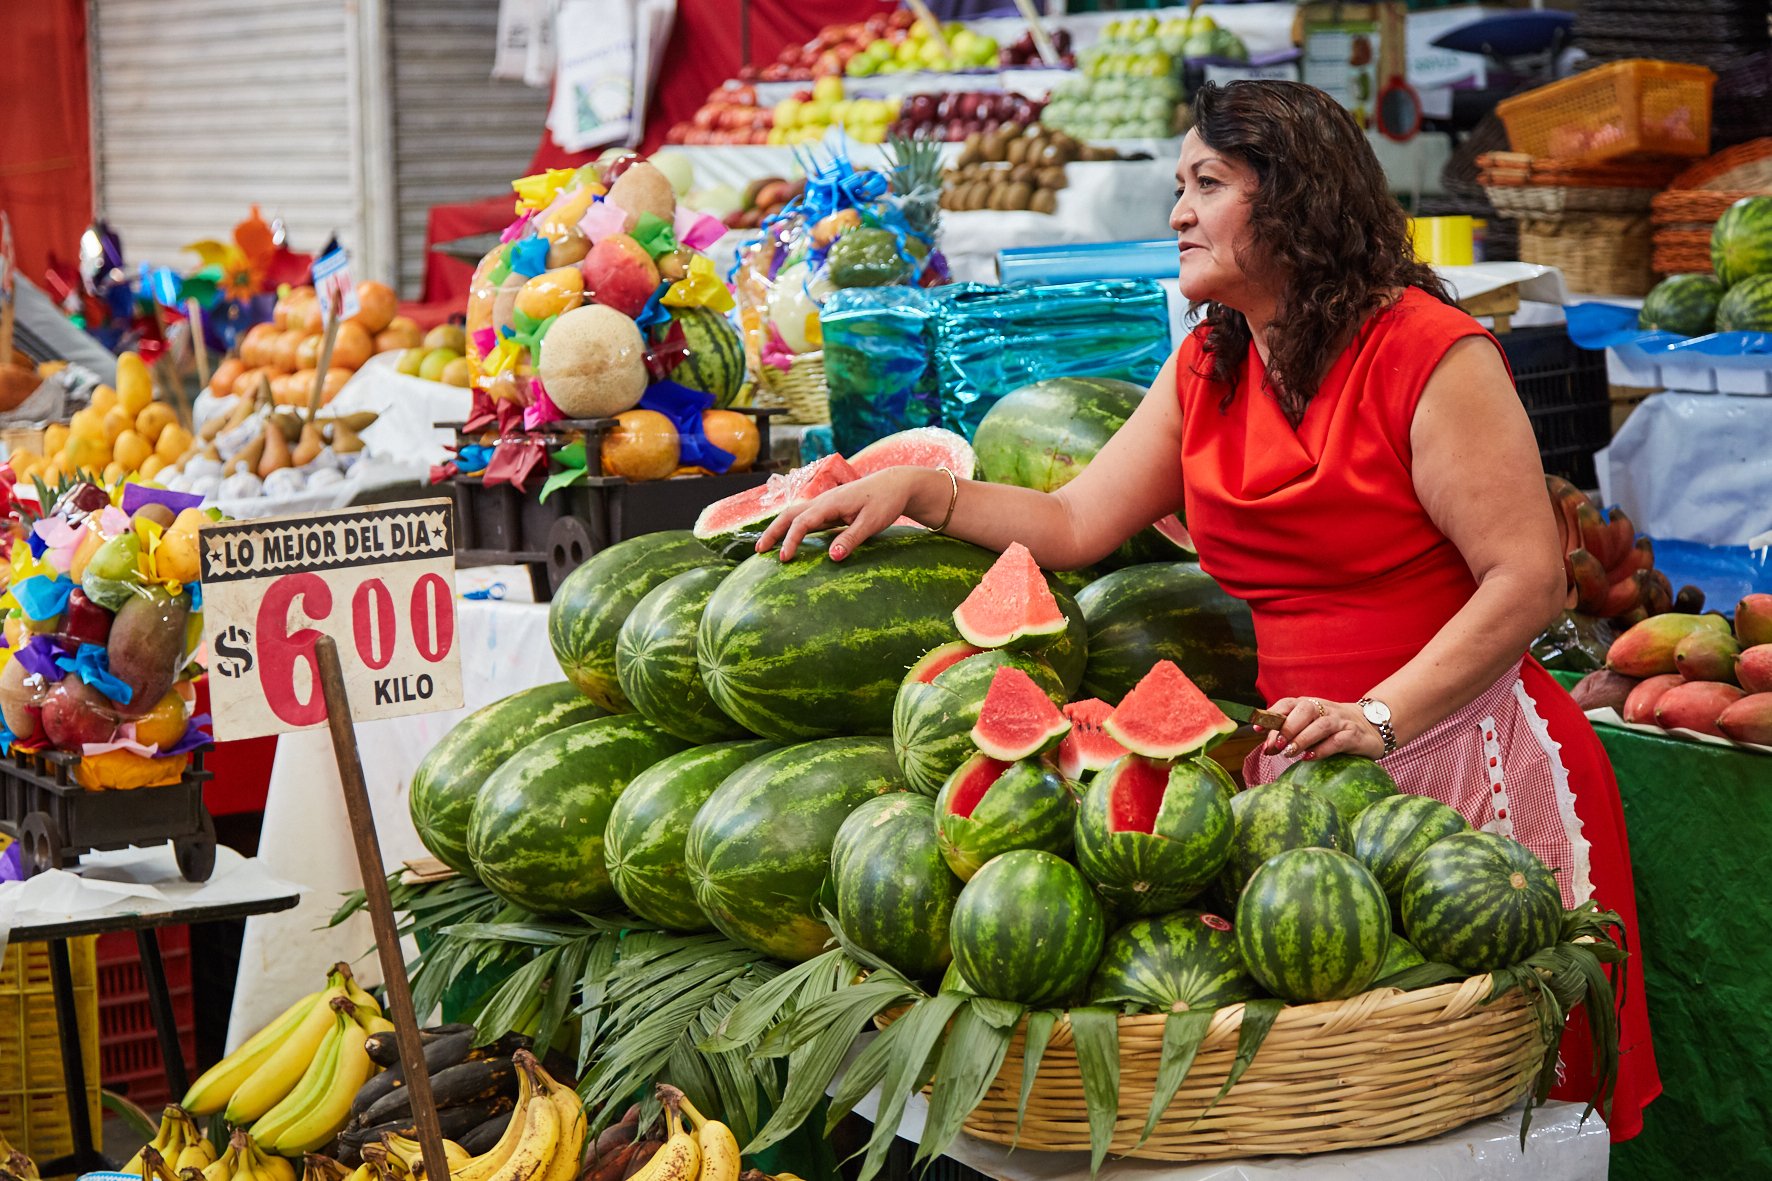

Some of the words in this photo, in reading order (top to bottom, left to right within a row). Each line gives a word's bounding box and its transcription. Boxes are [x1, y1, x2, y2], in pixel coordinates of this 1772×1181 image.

[225, 539, 254, 568] LO
[263, 530, 337, 564] MEJOR
[344, 525, 384, 554] DEL
[391, 520, 431, 549] DIA
[374, 673, 434, 705] KILO
